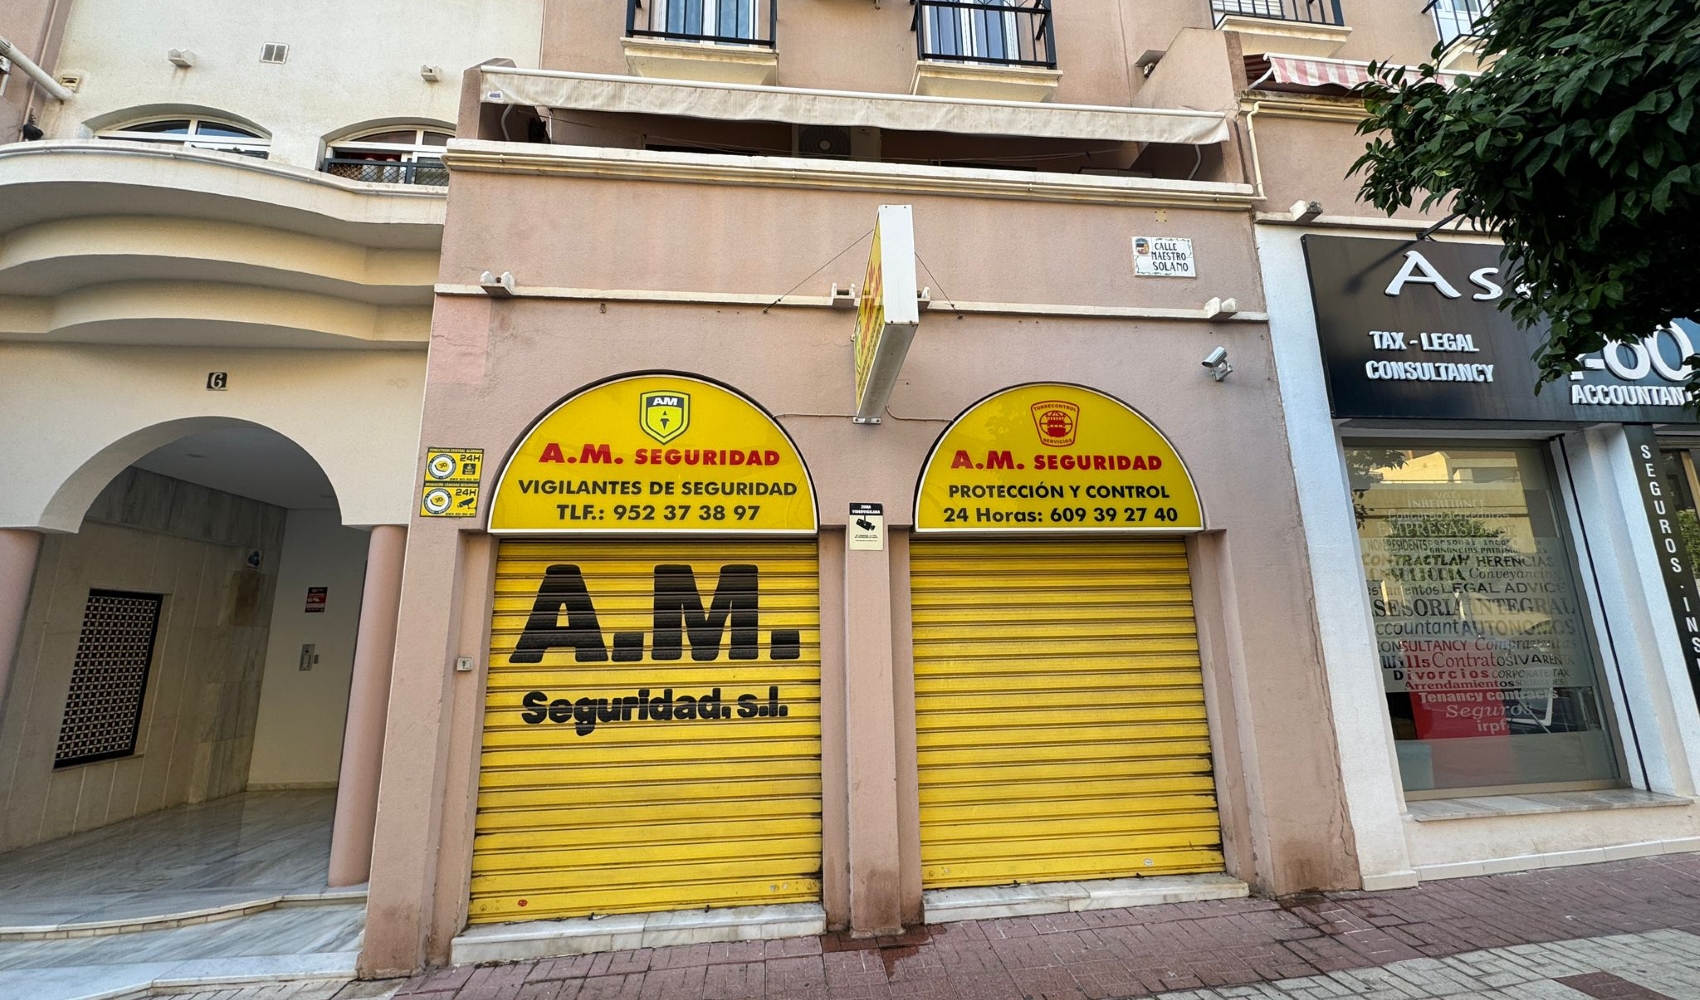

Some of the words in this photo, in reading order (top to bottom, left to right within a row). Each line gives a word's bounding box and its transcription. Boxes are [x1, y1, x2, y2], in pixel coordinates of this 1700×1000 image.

[1154, 242, 1178, 251] CALLE
[1151, 252, 1187, 261] MAESTRO
[1152, 262, 1189, 272] SOLANO
[1368, 330, 1407, 351] TAX
[1420, 332, 1480, 353] LEGAL
[1365, 360, 1495, 383] CONSULTANCY
[210, 372, 224, 390] 6
[652, 396, 678, 406] AM
[460, 454, 480, 462] 24H
[539, 443, 624, 465] A.M.
[635, 448, 780, 466] SEGURIDAD
[950, 450, 1025, 470] A.M.
[1034, 454, 1163, 471] SEGURIDAD
[455, 488, 477, 497] 24H
[518, 480, 642, 496] VIGILANTES
[649, 481, 675, 496] DE
[681, 481, 798, 497] SEGURIDAD
[948, 481, 1065, 499] PROTECCIÓN
[1068, 485, 1080, 498] Y
[1086, 484, 1170, 499] CONTROL
[556, 504, 605, 521] TLF.:
[613, 504, 657, 521] 952
[663, 504, 692, 521] 37
[698, 505, 726, 521] 38
[735, 505, 761, 521] 97
[943, 507, 969, 523] 24
[976, 507, 1043, 523] Horas:
[1050, 507, 1086, 523] 609
[1094, 507, 1118, 523] 39
[1124, 507, 1146, 523] 27
[1153, 507, 1178, 523] 40
[1640, 444, 1682, 573] SEGUROS
[1378, 521, 1469, 537] EMPRESAS
[1476, 556, 1554, 568] HERENCIAS
[1368, 567, 1466, 582] ONSULTORIA
[1367, 583, 1439, 595] estamentos
[1442, 582, 1500, 594] LEGAL
[1504, 582, 1567, 595] ADVICE
[508, 563, 801, 664] A.M.
[1371, 598, 1467, 618] SESORIA
[1376, 620, 1458, 636] ccountant
[1377, 639, 1468, 653] ONSULTANCY
[1382, 654, 1431, 669] Wills
[1431, 651, 1513, 668] Contratos
[1393, 667, 1490, 681] Divorcios
[1552, 667, 1571, 678] TAX
[1405, 679, 1515, 692] Arrendamientos
[736, 685, 788, 719] s.l.
[1418, 691, 1484, 705] Tenancy
[1487, 688, 1559, 702] contracts
[1445, 704, 1533, 720] Seguros
